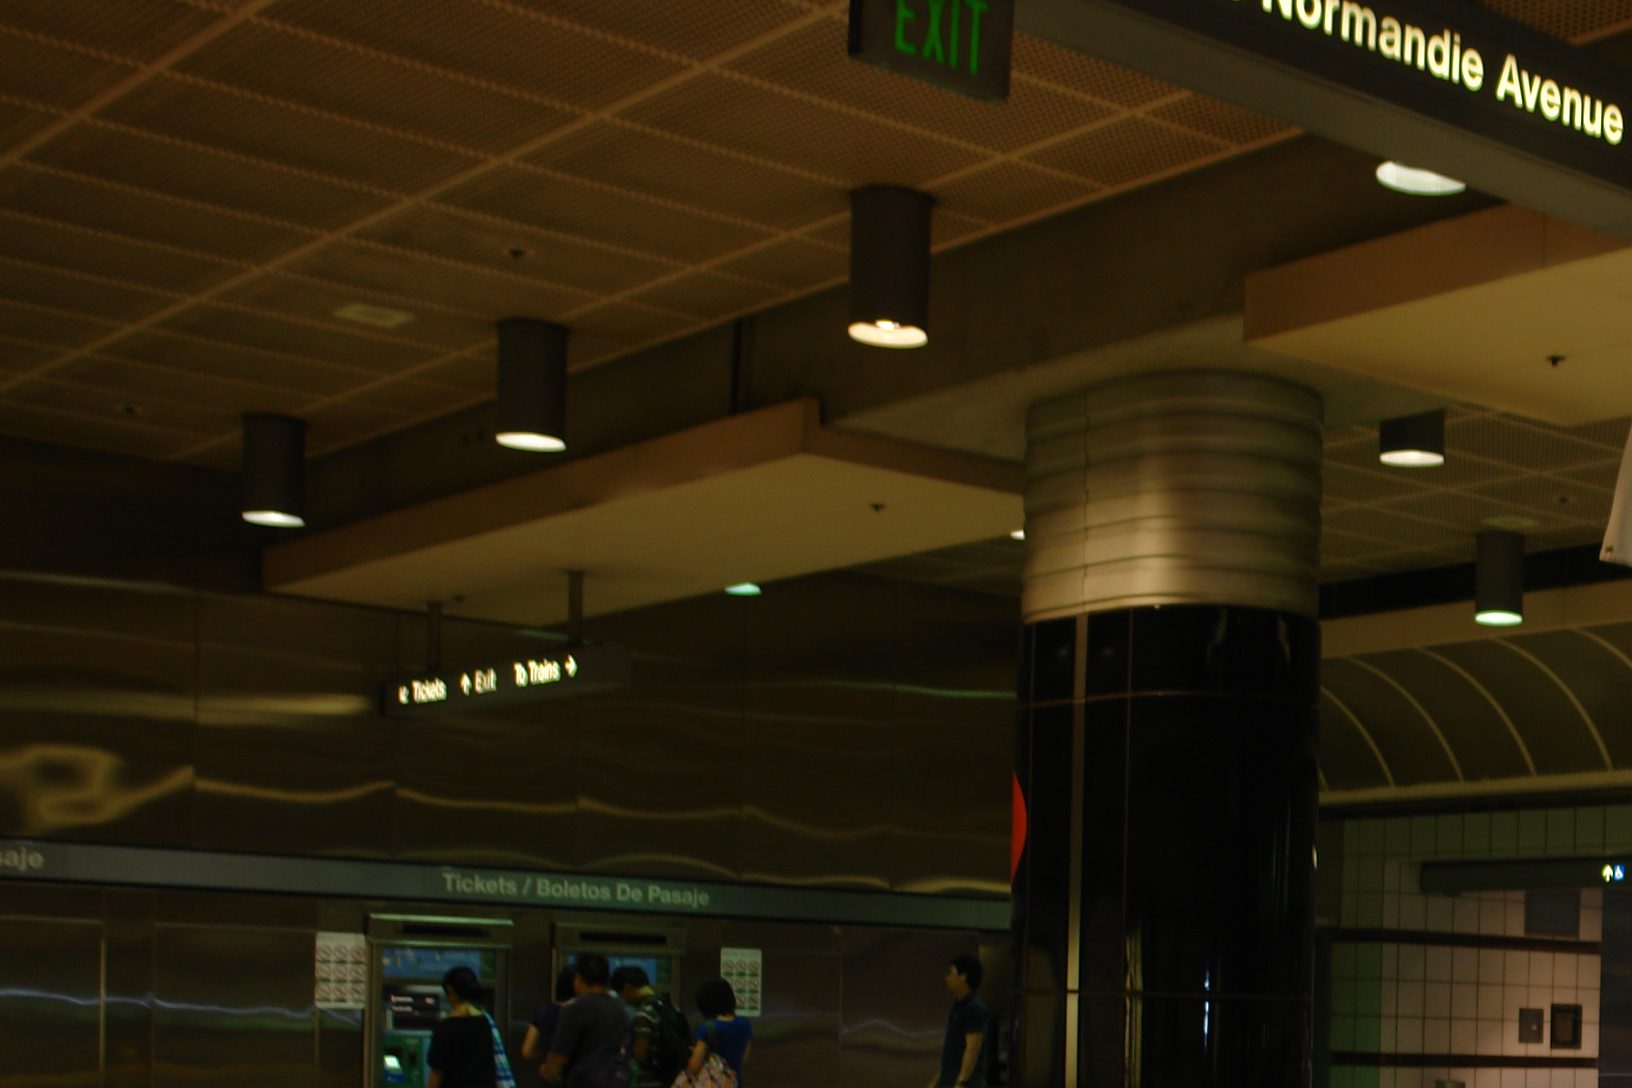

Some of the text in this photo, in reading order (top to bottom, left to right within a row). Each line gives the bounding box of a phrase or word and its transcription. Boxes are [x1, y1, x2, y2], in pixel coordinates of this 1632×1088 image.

[894, 0, 990, 76] EXIT
[1496, 53, 1625, 146] Avenue
[474, 667, 497, 694] Exit
[513, 658, 561, 687] To Trains
[411, 677, 447, 704] Tickets
[0, 846, 45, 872] aje
[442, 871, 710, 909] Tickets / Boletos De Pasaje
